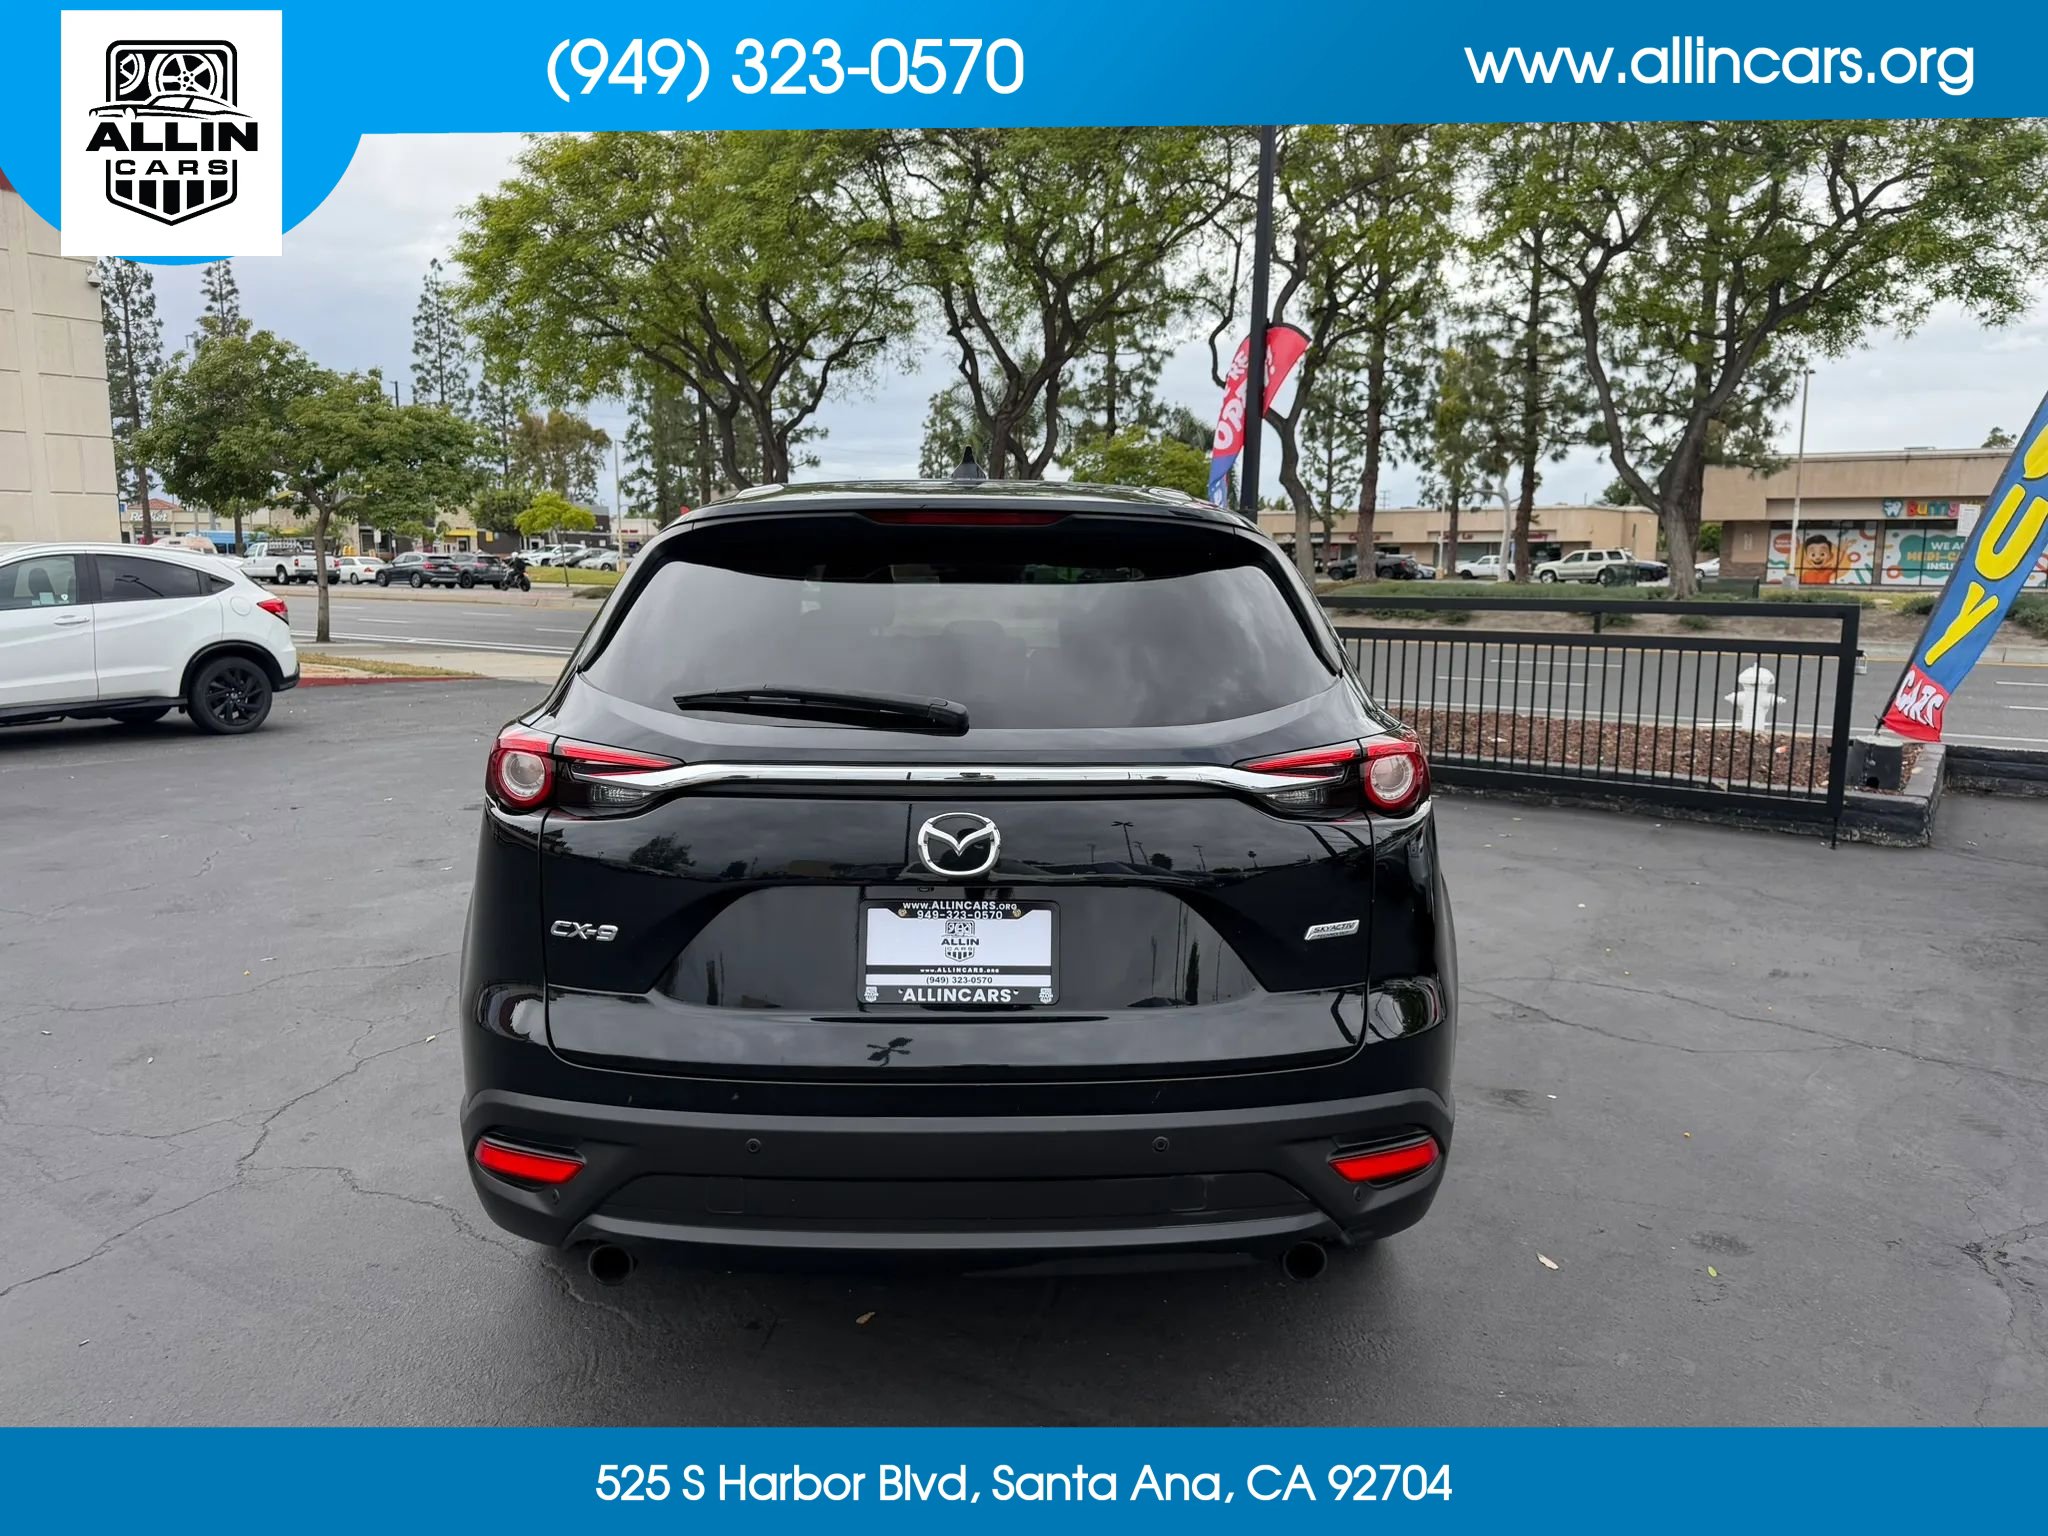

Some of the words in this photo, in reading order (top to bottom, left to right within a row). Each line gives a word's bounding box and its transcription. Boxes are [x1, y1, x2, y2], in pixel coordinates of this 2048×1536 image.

[1895, 669, 1944, 728] CARS
[917, 910, 1003, 920] 949-323-0570
[550, 920, 619, 942] CX-9
[1314, 922, 1355, 933] SKYACTIV
[941, 938, 980, 946] ALLIN
[926, 976, 949, 985] (949)
[952, 976, 993, 984] 323-0570
[903, 988, 1012, 1002] ALLINCARS
